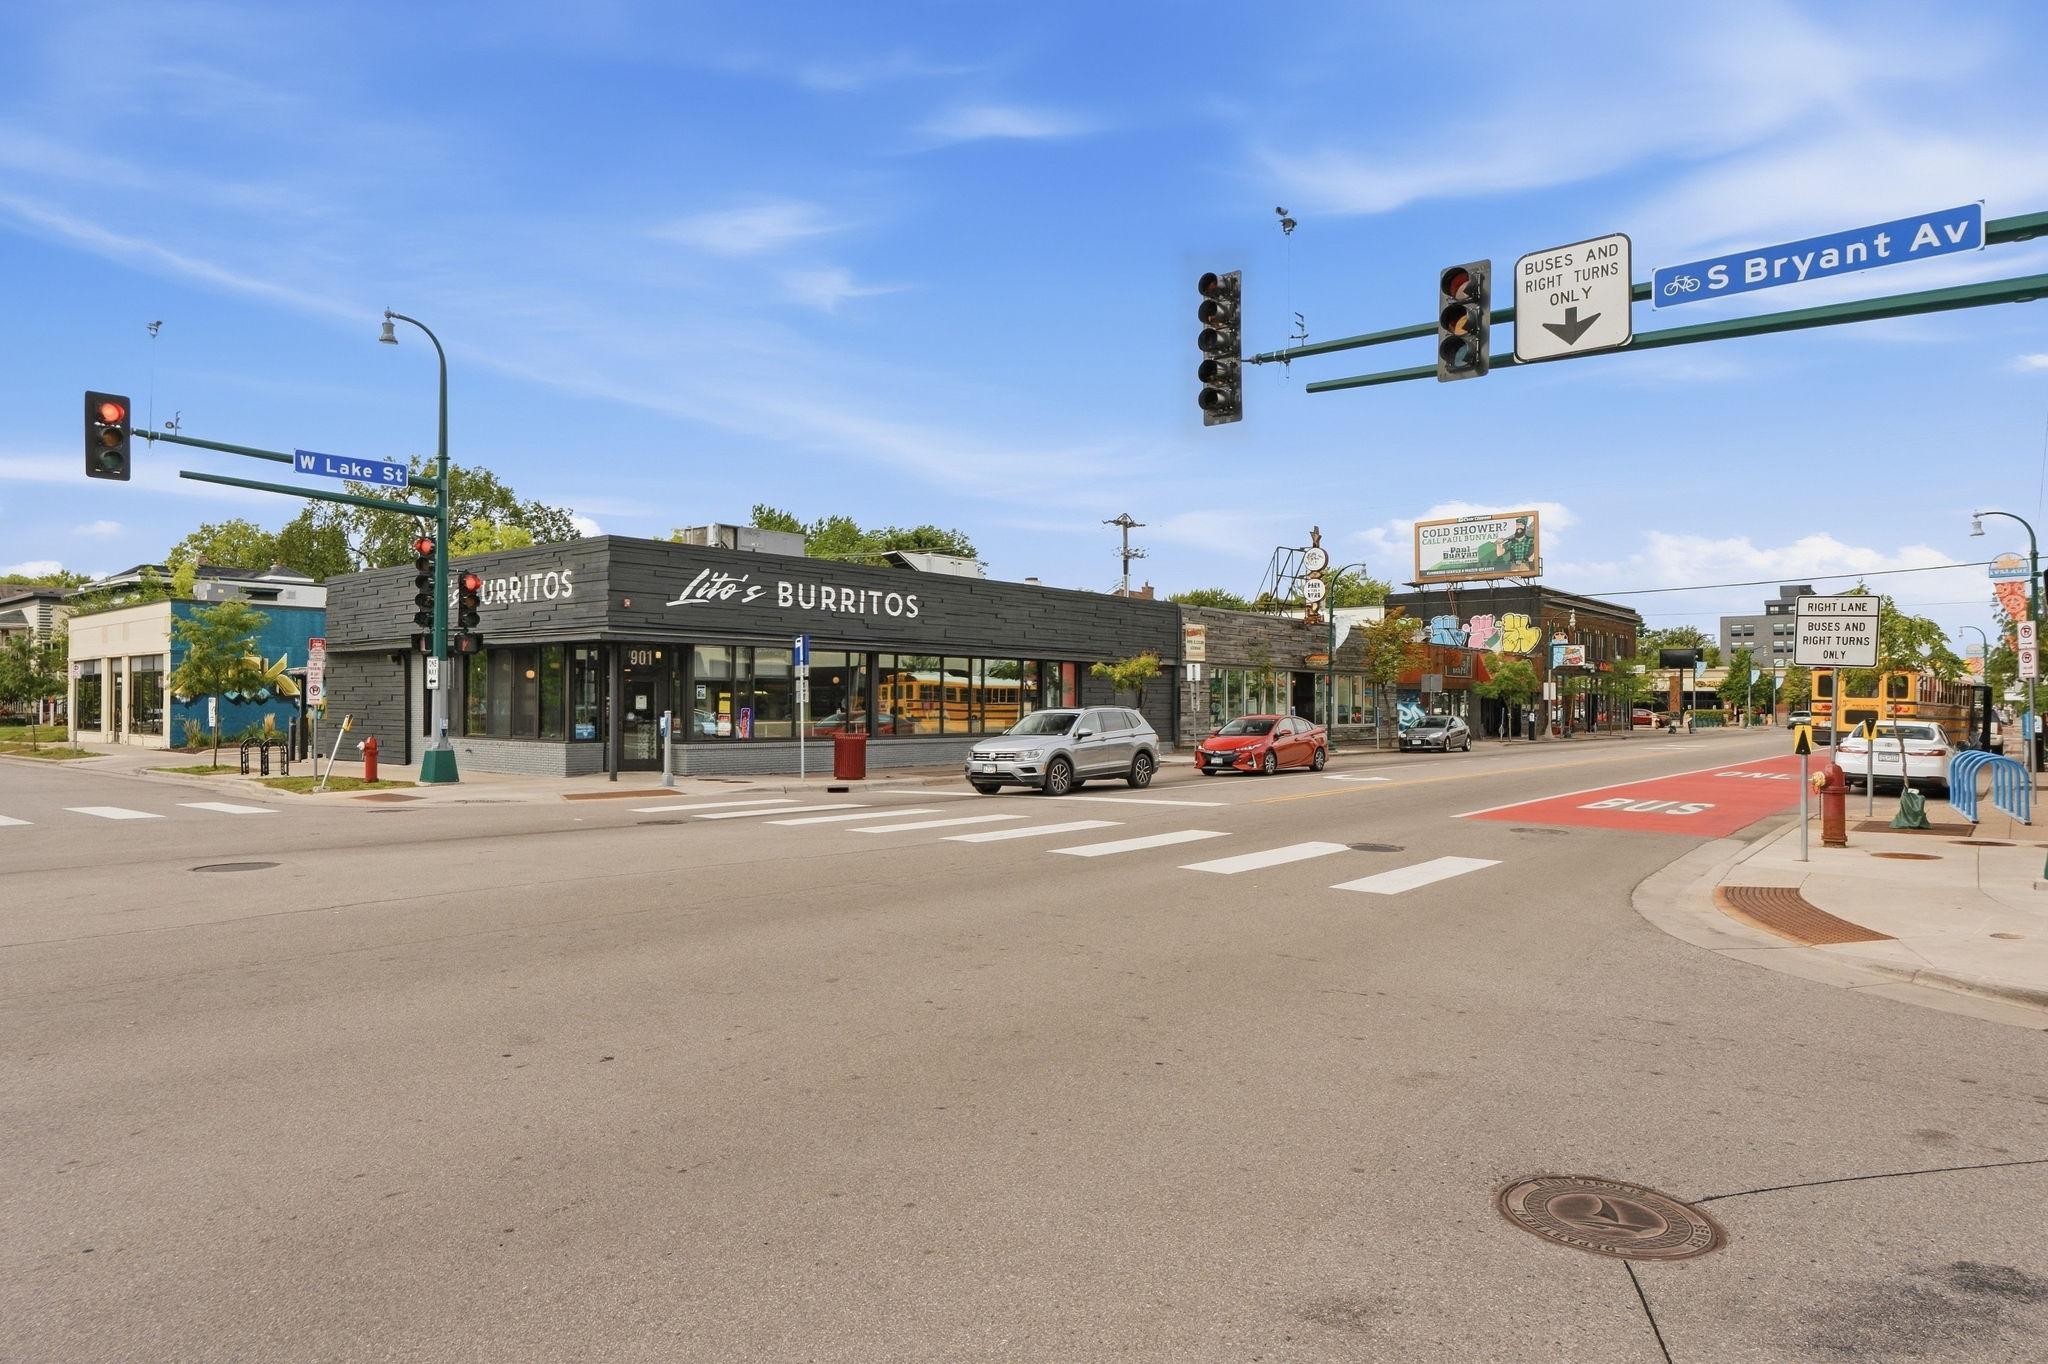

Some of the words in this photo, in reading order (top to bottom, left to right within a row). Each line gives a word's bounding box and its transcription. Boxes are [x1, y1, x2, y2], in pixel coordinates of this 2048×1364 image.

[1525, 254, 1573, 276] BUSES
[1586, 244, 1619, 263] AND
[1707, 265, 1729, 290] S
[1744, 233, 1891, 283] Bryant
[1909, 221, 1969, 252] Av
[1525, 274, 1563, 294] RIGHT
[1574, 262, 1619, 283] TURNS
[1550, 286, 1592, 306] ONLY
[300, 454, 316, 470] W
[326, 458, 373, 478] Lake
[383, 466, 403, 482] St
[1422, 527, 1451, 539] COLD
[1453, 521, 1508, 536] SHOWER?
[1422, 538, 1442, 546] CALL
[1442, 535, 1462, 544] PAUL
[1464, 532, 1499, 542] BUNYAN
[1443, 550, 1478, 560] Bunyan
[1450, 545, 1471, 553] Paul
[480, 568, 573, 605] URRITOS
[666, 568, 767, 607] Lito's
[778, 581, 920, 619] BURRITOS
[1807, 602, 1837, 612] RIGHT
[1841, 602, 1868, 612] LANE
[1807, 622, 1840, 632] BUSES
[1844, 622, 1866, 632] AND
[1802, 636, 1832, 645] RIGHT
[1836, 636, 1870, 646] TURNS
[630, 650, 653, 666] 901
[1823, 650, 1846, 660] ONLY
[1714, 771, 1794, 780] ONL
[1577, 798, 1716, 815] BUS
